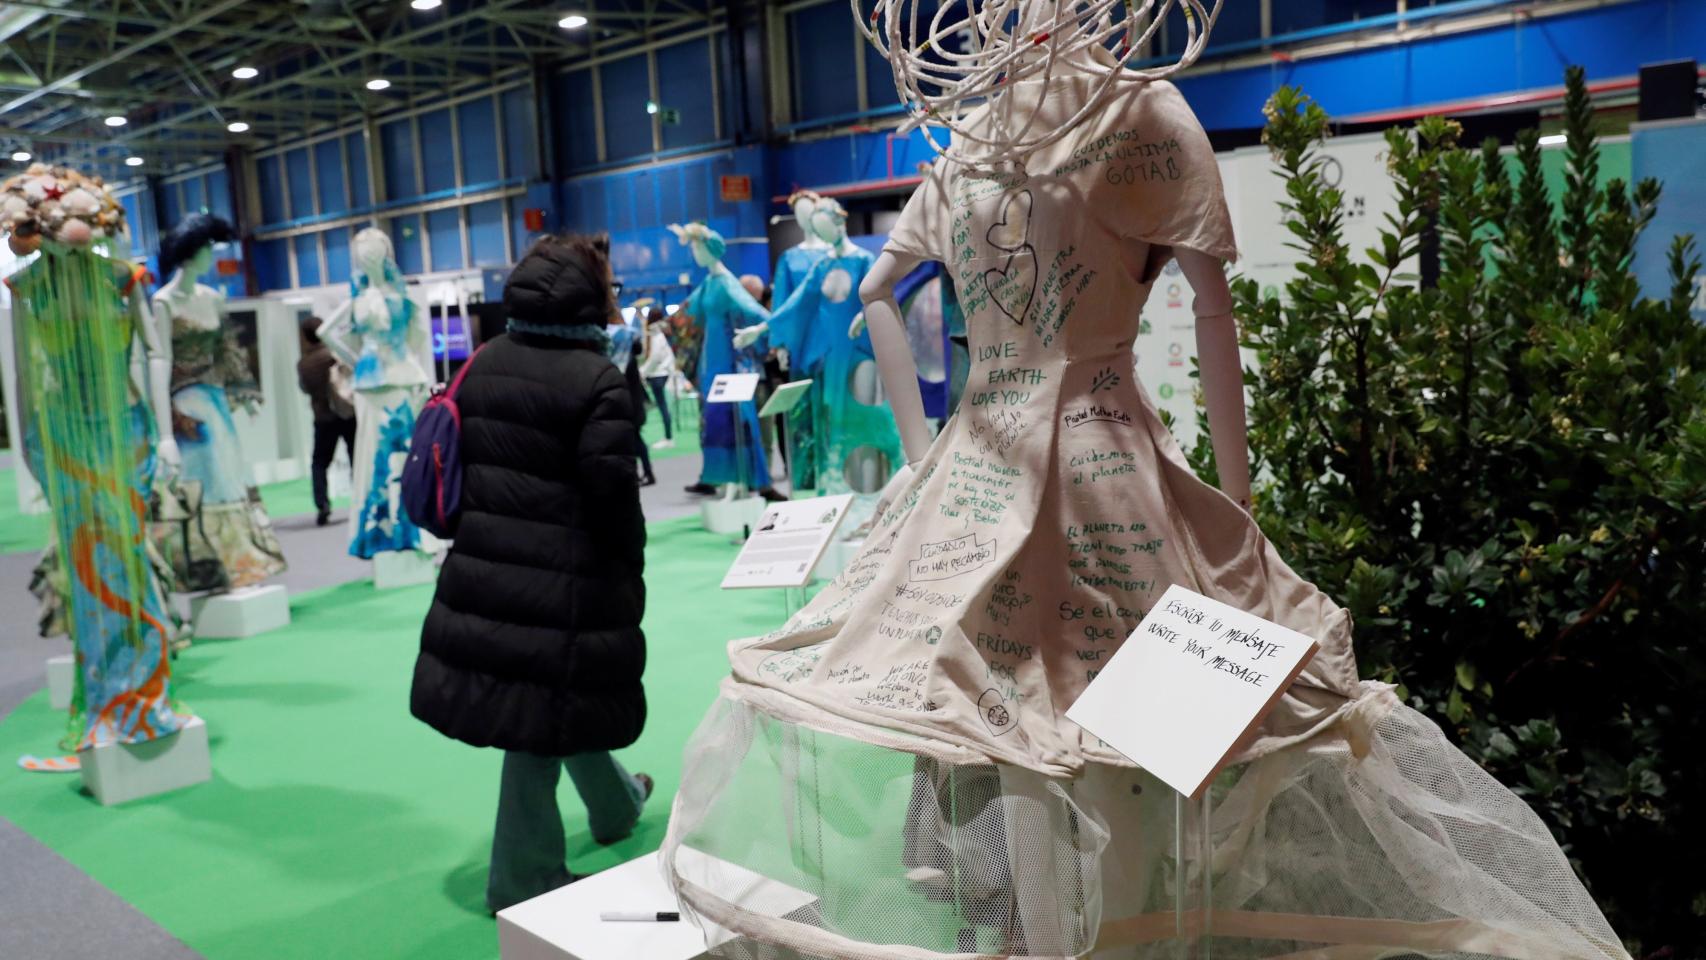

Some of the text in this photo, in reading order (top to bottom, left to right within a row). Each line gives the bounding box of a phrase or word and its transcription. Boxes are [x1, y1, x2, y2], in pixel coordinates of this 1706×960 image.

[1073, 128, 1139, 159] CUIDEMOS
[1055, 158, 1092, 178] HASTA
[1095, 150, 1114, 163] LA
[978, 342, 1019, 362] LOVE
[988, 367, 1047, 385] EARTH
[971, 390, 1031, 407] LOVE YOU
[1091, 463, 1136, 483] planeta
[1083, 522, 1125, 536] PLANETA
[916, 564, 929, 576] NO
[1084, 625, 1116, 642] que
[1163, 600, 1207, 626] ESCRIBE
[1217, 628, 1285, 660] MENSAJE
[1148, 622, 1180, 644] WRITE
[1183, 638, 1212, 659] YOUR
[1206, 655, 1269, 687] MESSAGE
[988, 660, 1018, 685] FOR
